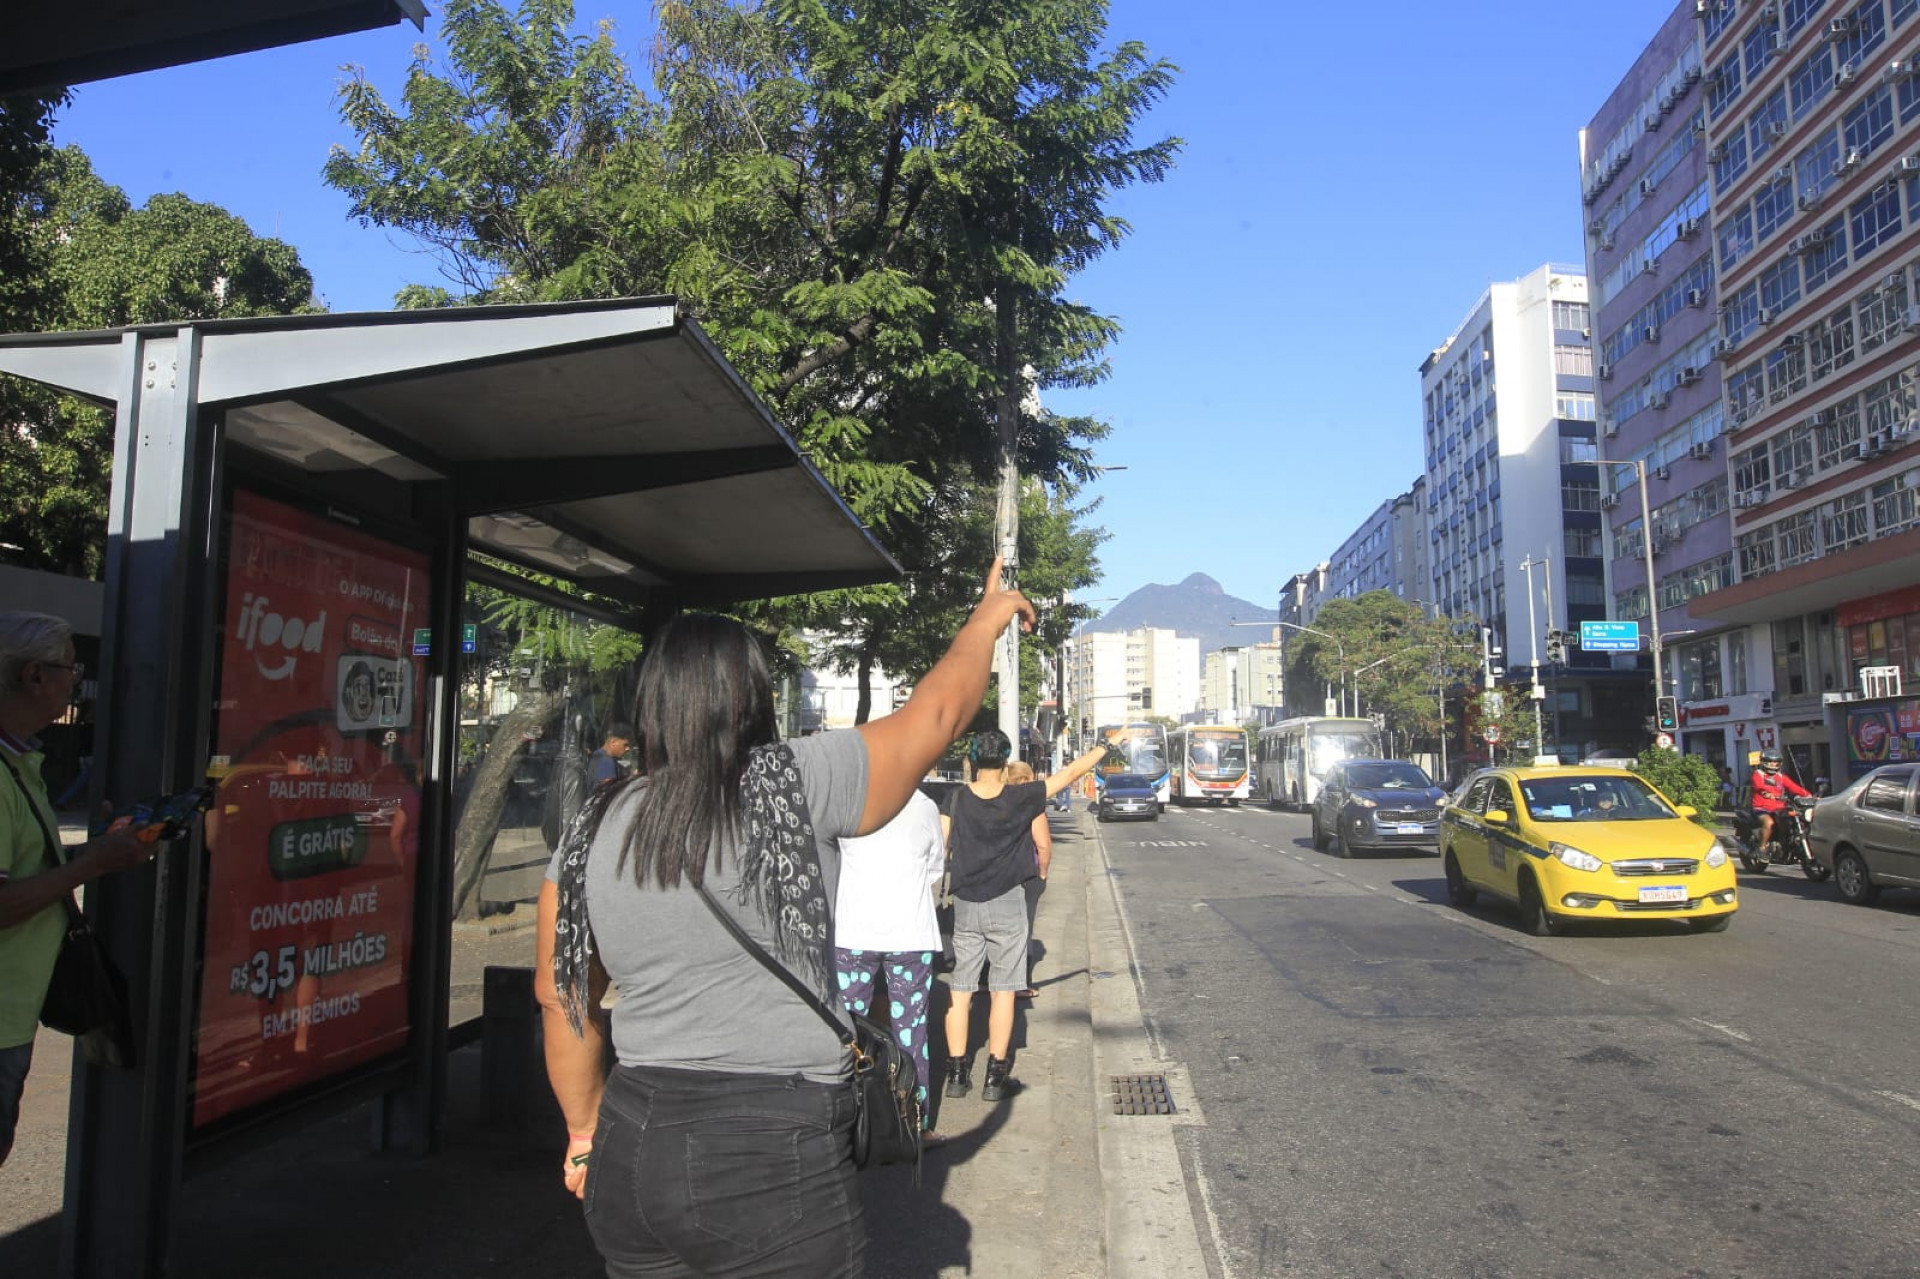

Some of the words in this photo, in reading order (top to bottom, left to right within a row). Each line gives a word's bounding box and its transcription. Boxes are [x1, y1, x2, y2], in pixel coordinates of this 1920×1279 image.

[340, 580, 349, 595] O
[350, 581, 373, 600] APP
[236, 592, 327, 653] ifood
[296, 754, 330, 776] FAÇA
[332, 756, 353, 775] SEU
[268, 780, 327, 799] PALPITE
[328, 781, 372, 800] AGORA!
[282, 828, 295, 861] É
[299, 824, 355, 856] GRÁTIS
[250, 896, 345, 931] CONCORRA
[348, 885, 378, 917] ATÉ
[230, 961, 249, 990] R$
[250, 946, 296, 999] 3,5
[304, 933, 386, 975] MILHÕES
[263, 1010, 287, 1039] EM
[291, 992, 361, 1027] PRÊMIOS
